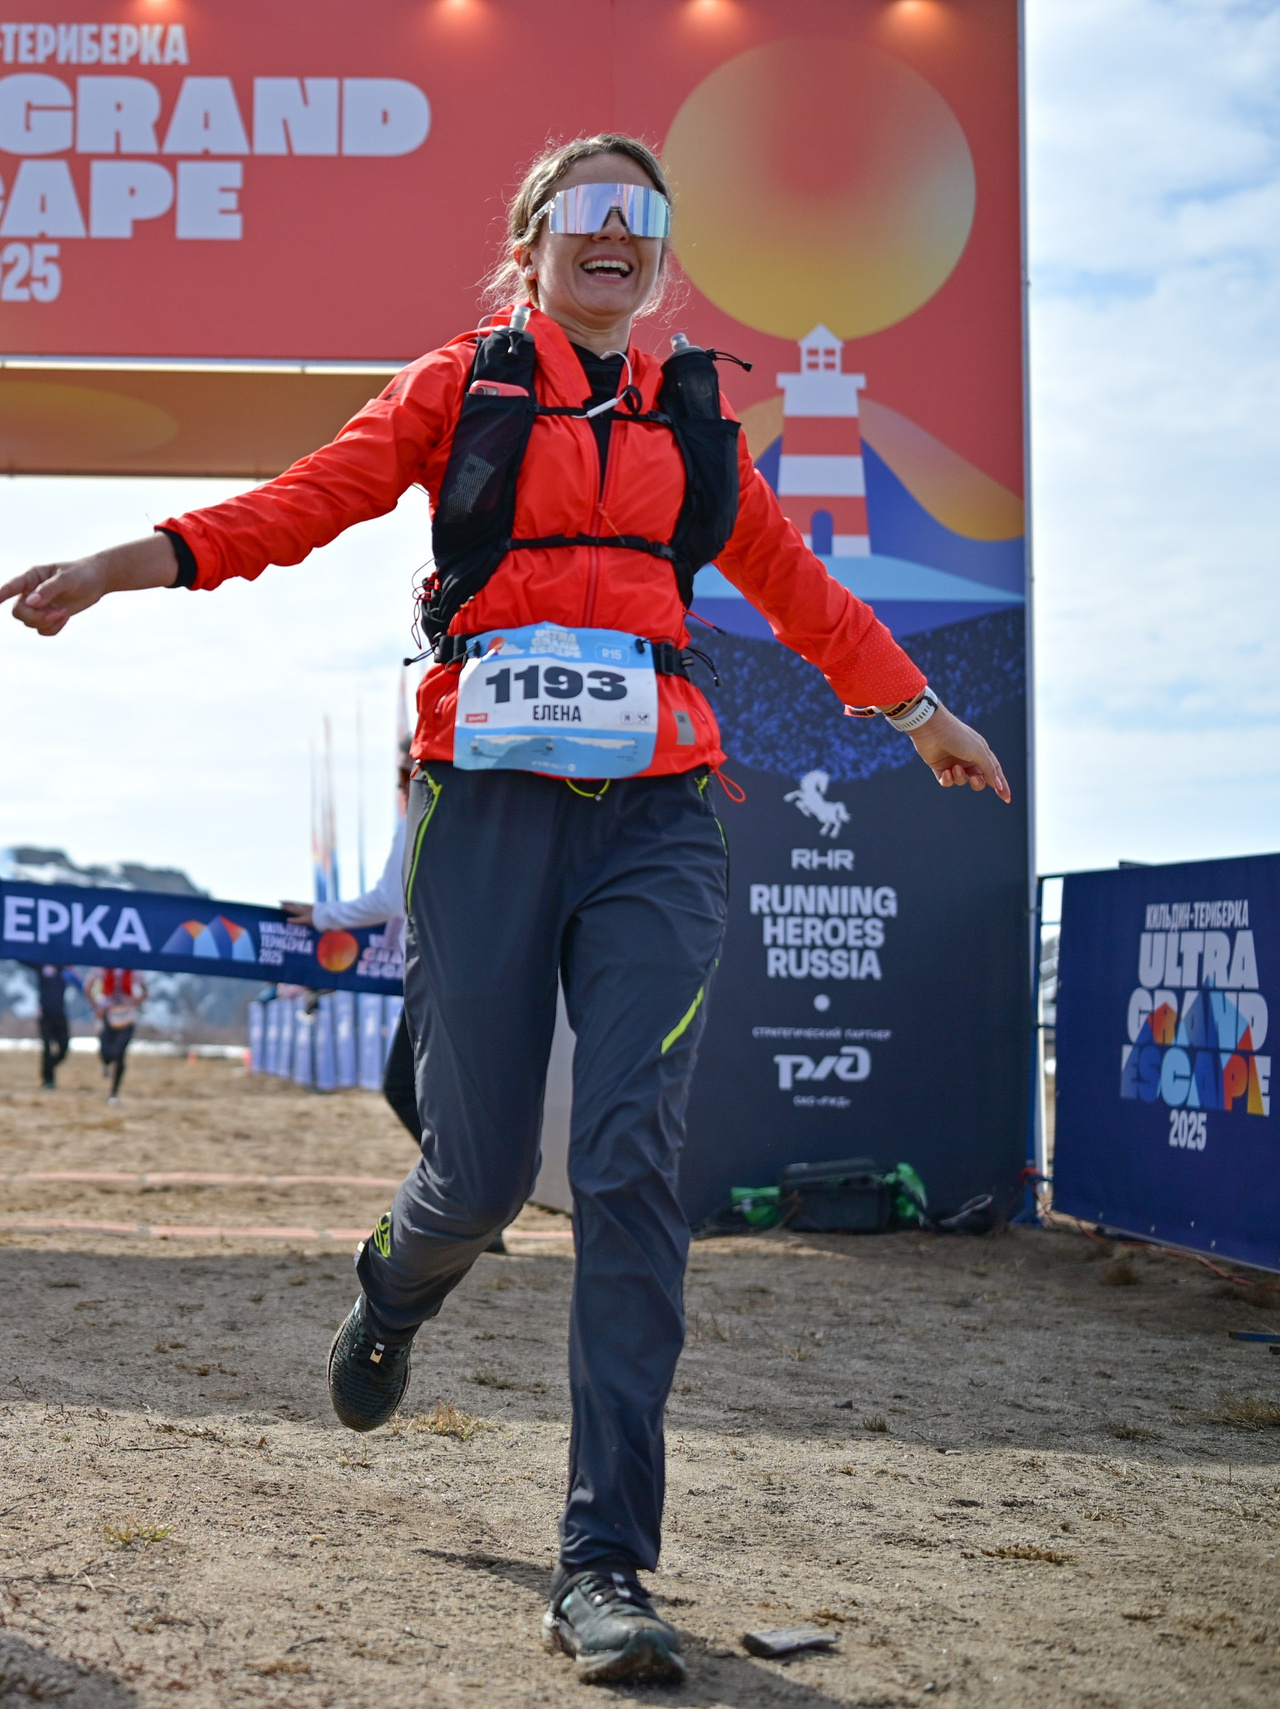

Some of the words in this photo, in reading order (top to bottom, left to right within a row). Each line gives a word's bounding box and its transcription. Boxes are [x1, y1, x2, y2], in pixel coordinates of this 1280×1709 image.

[485, 664, 628, 704] 1193
[533, 704, 582, 722] ЕЛЕНА
[791, 848, 854, 871] RHR
[750, 884, 898, 918] RUNNING
[1145, 901, 1249, 932] КИЛЬДИН-ТЕРИБЕРКА
[763, 916, 885, 948] HEROES
[767, 948, 882, 980] RUSSIA
[1138, 930, 1259, 990] ULTRA
[1127, 987, 1268, 1051] GRAND
[1120, 1044, 1271, 1117] ESCAPE
[1169, 1108, 1207, 1151] 2025
